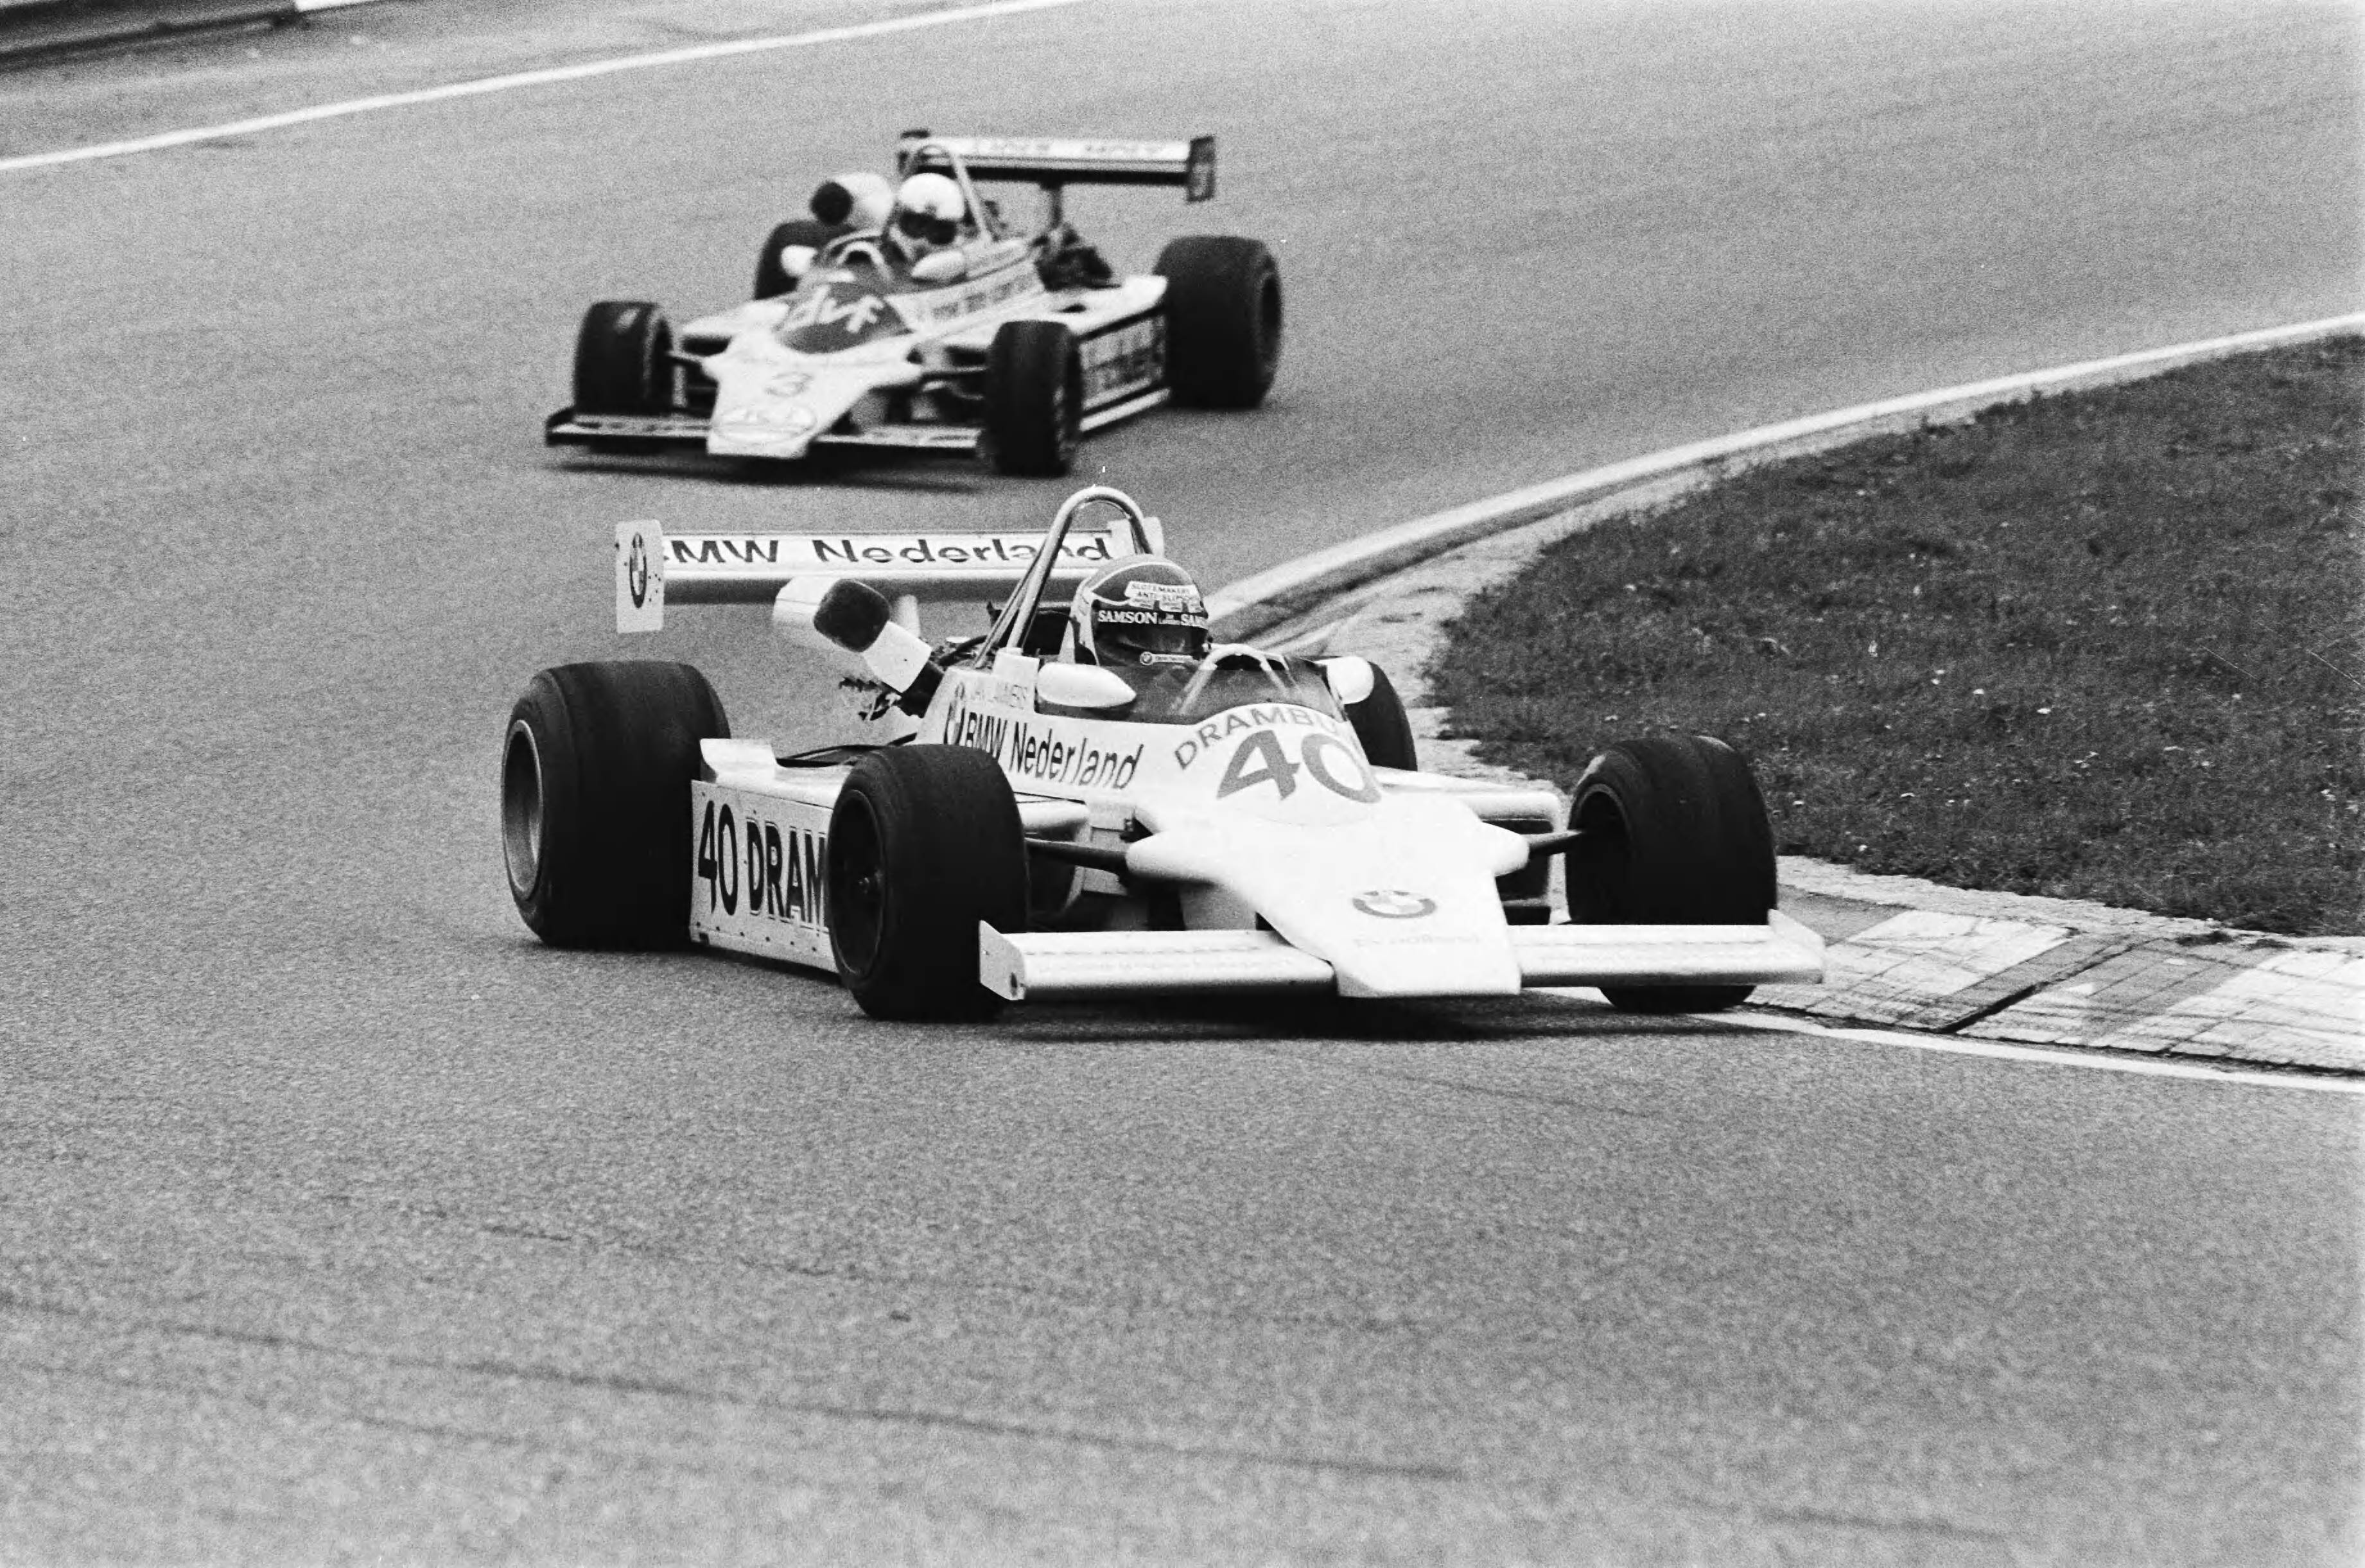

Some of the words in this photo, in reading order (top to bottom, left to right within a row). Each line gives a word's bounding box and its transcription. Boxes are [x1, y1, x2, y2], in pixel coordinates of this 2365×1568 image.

[764, 370, 814, 399] 3
[664, 540, 778, 563] MW
[811, 538, 1113, 564] Nederland
[1097, 610, 1158, 625] SAMSON
[964, 711, 1008, 759] BMW
[1009, 721, 1145, 790] Nederland
[1174, 706, 1364, 770] DRAMBU
[1216, 729, 1382, 804] 40
[697, 800, 738, 916] 40
[745, 816, 830, 934] DRAM
